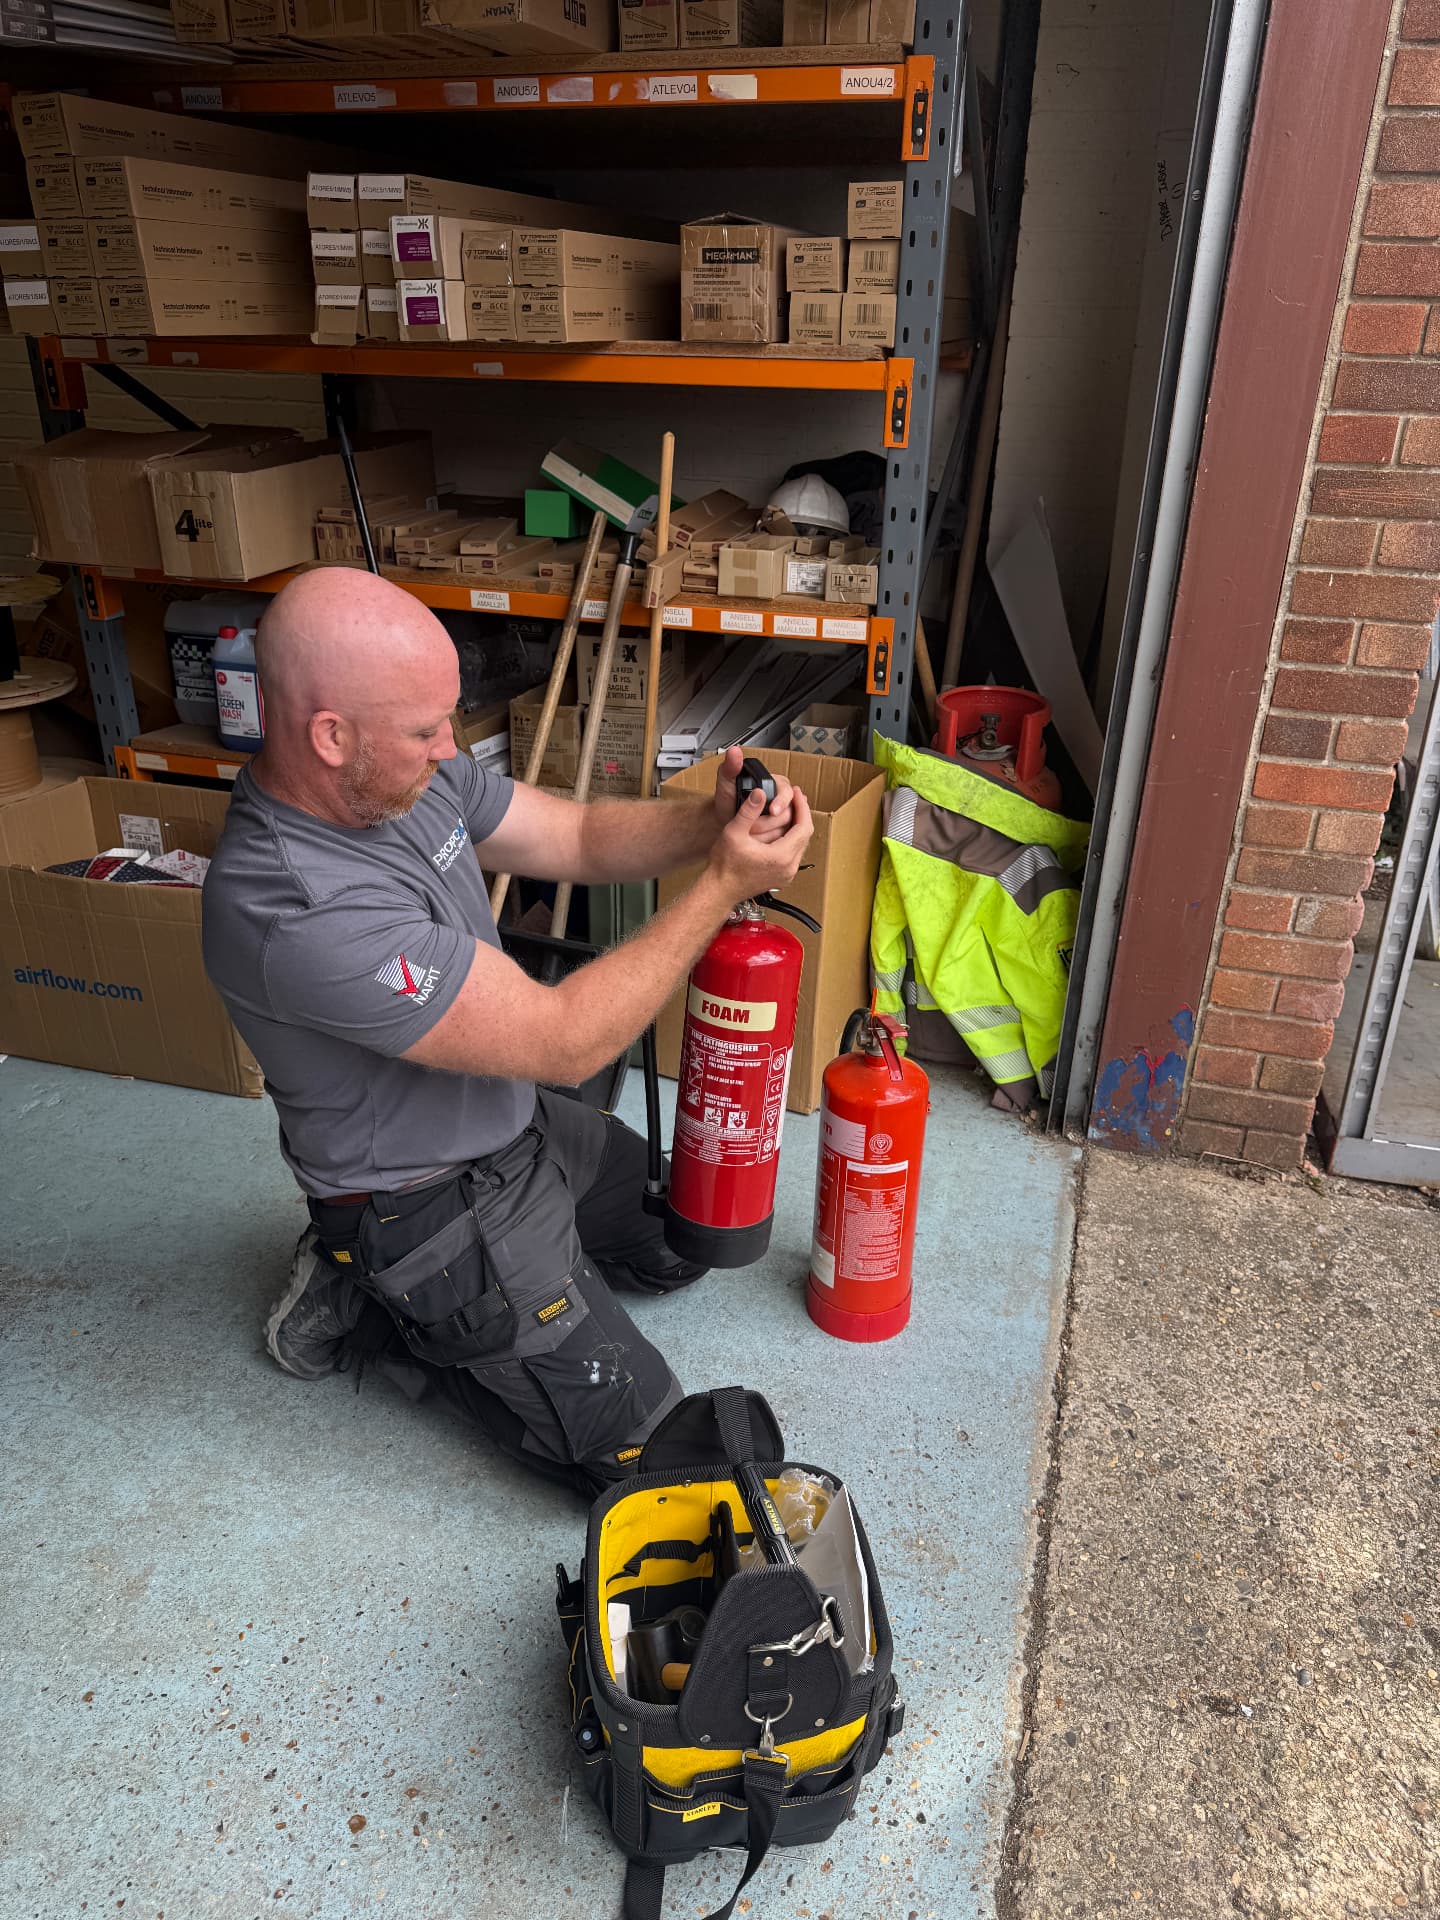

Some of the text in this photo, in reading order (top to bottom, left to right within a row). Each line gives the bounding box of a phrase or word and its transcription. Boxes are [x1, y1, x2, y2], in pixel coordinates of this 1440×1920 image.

[845, 75, 893, 89] ANOU4/2
[497, 84, 538, 97] ANOU5/2
[652, 83, 697, 97] ATLEVO4
[479, 592, 503, 601] ANSELL
[476, 600, 506, 609] AMALL2/1
[663, 608, 685, 616] NSELL
[729, 613, 755, 622] ANSELL
[783, 618, 809, 626] ANSELL
[833, 622, 857, 630] ANSELL
[607, 684, 629, 692] RAGILE
[219, 697, 245, 711] SCREEN
[220, 707, 242, 721] WASH
[14, 965, 144, 1002] airflow.com
[413, 965, 441, 1006] NAPIT
[701, 999, 751, 1024] FOAM
[703, 1034, 759, 1052] EXTINGUISHER
[763, 1498, 782, 1532] STANLEY
[686, 1804, 717, 1817] STANLEY
